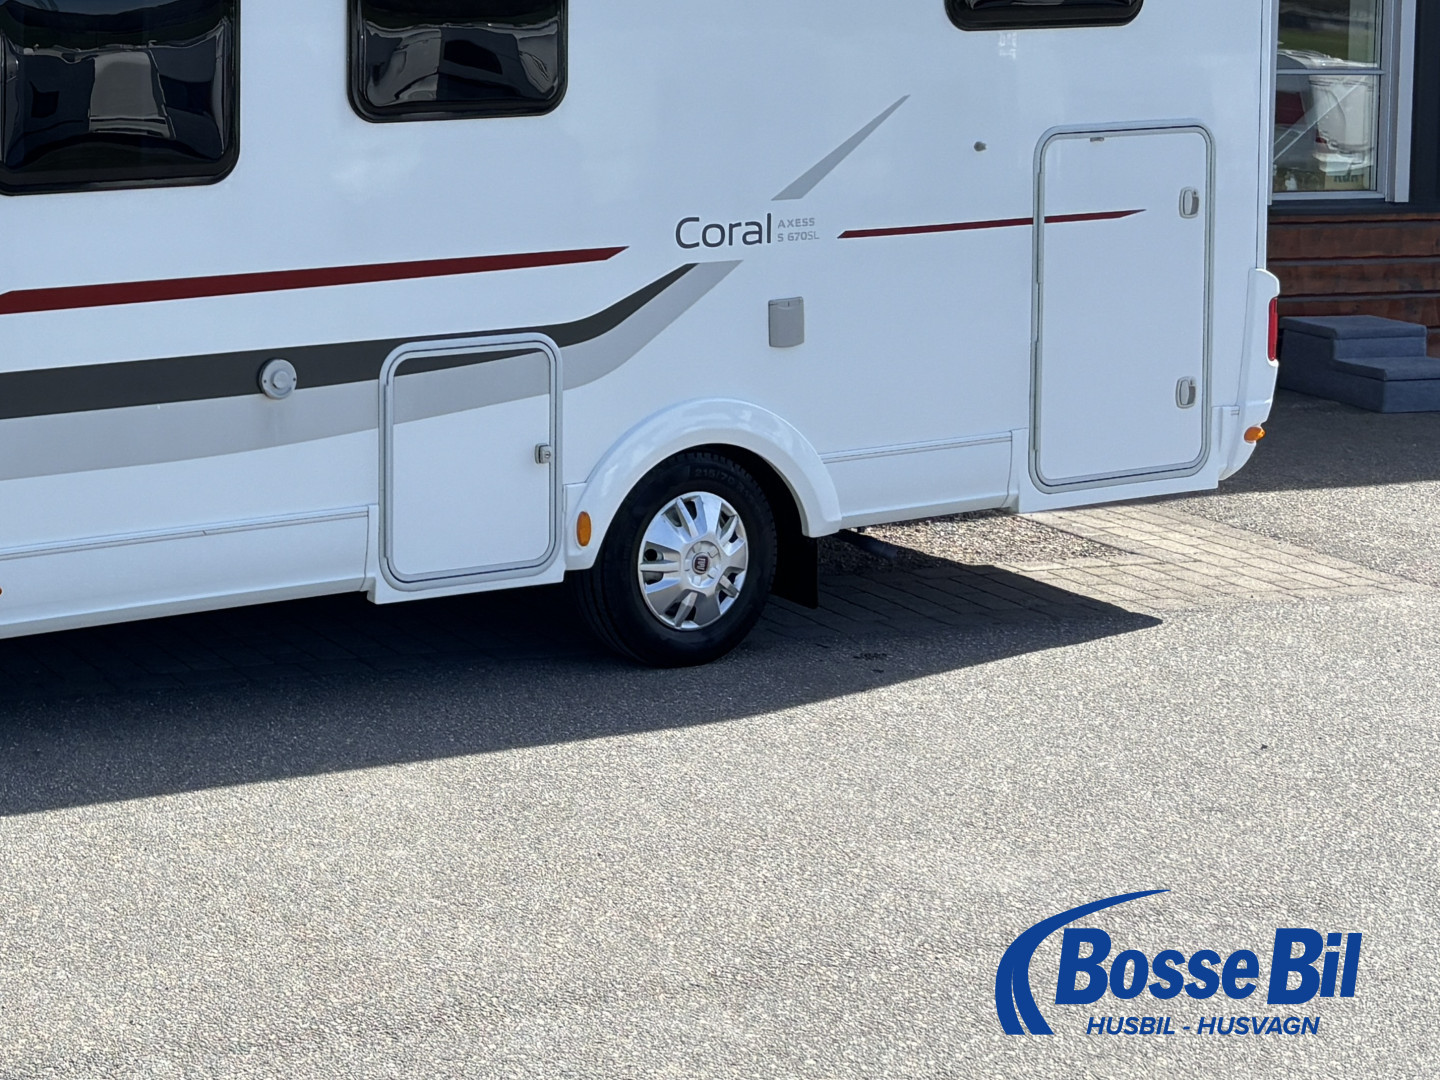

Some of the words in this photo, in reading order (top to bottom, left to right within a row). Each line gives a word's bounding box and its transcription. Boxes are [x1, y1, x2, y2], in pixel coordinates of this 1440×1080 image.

[777, 217, 816, 229] AXESS
[675, 212, 772, 249] Coral
[777, 234, 785, 242] S
[787, 231, 820, 242] 670SL
